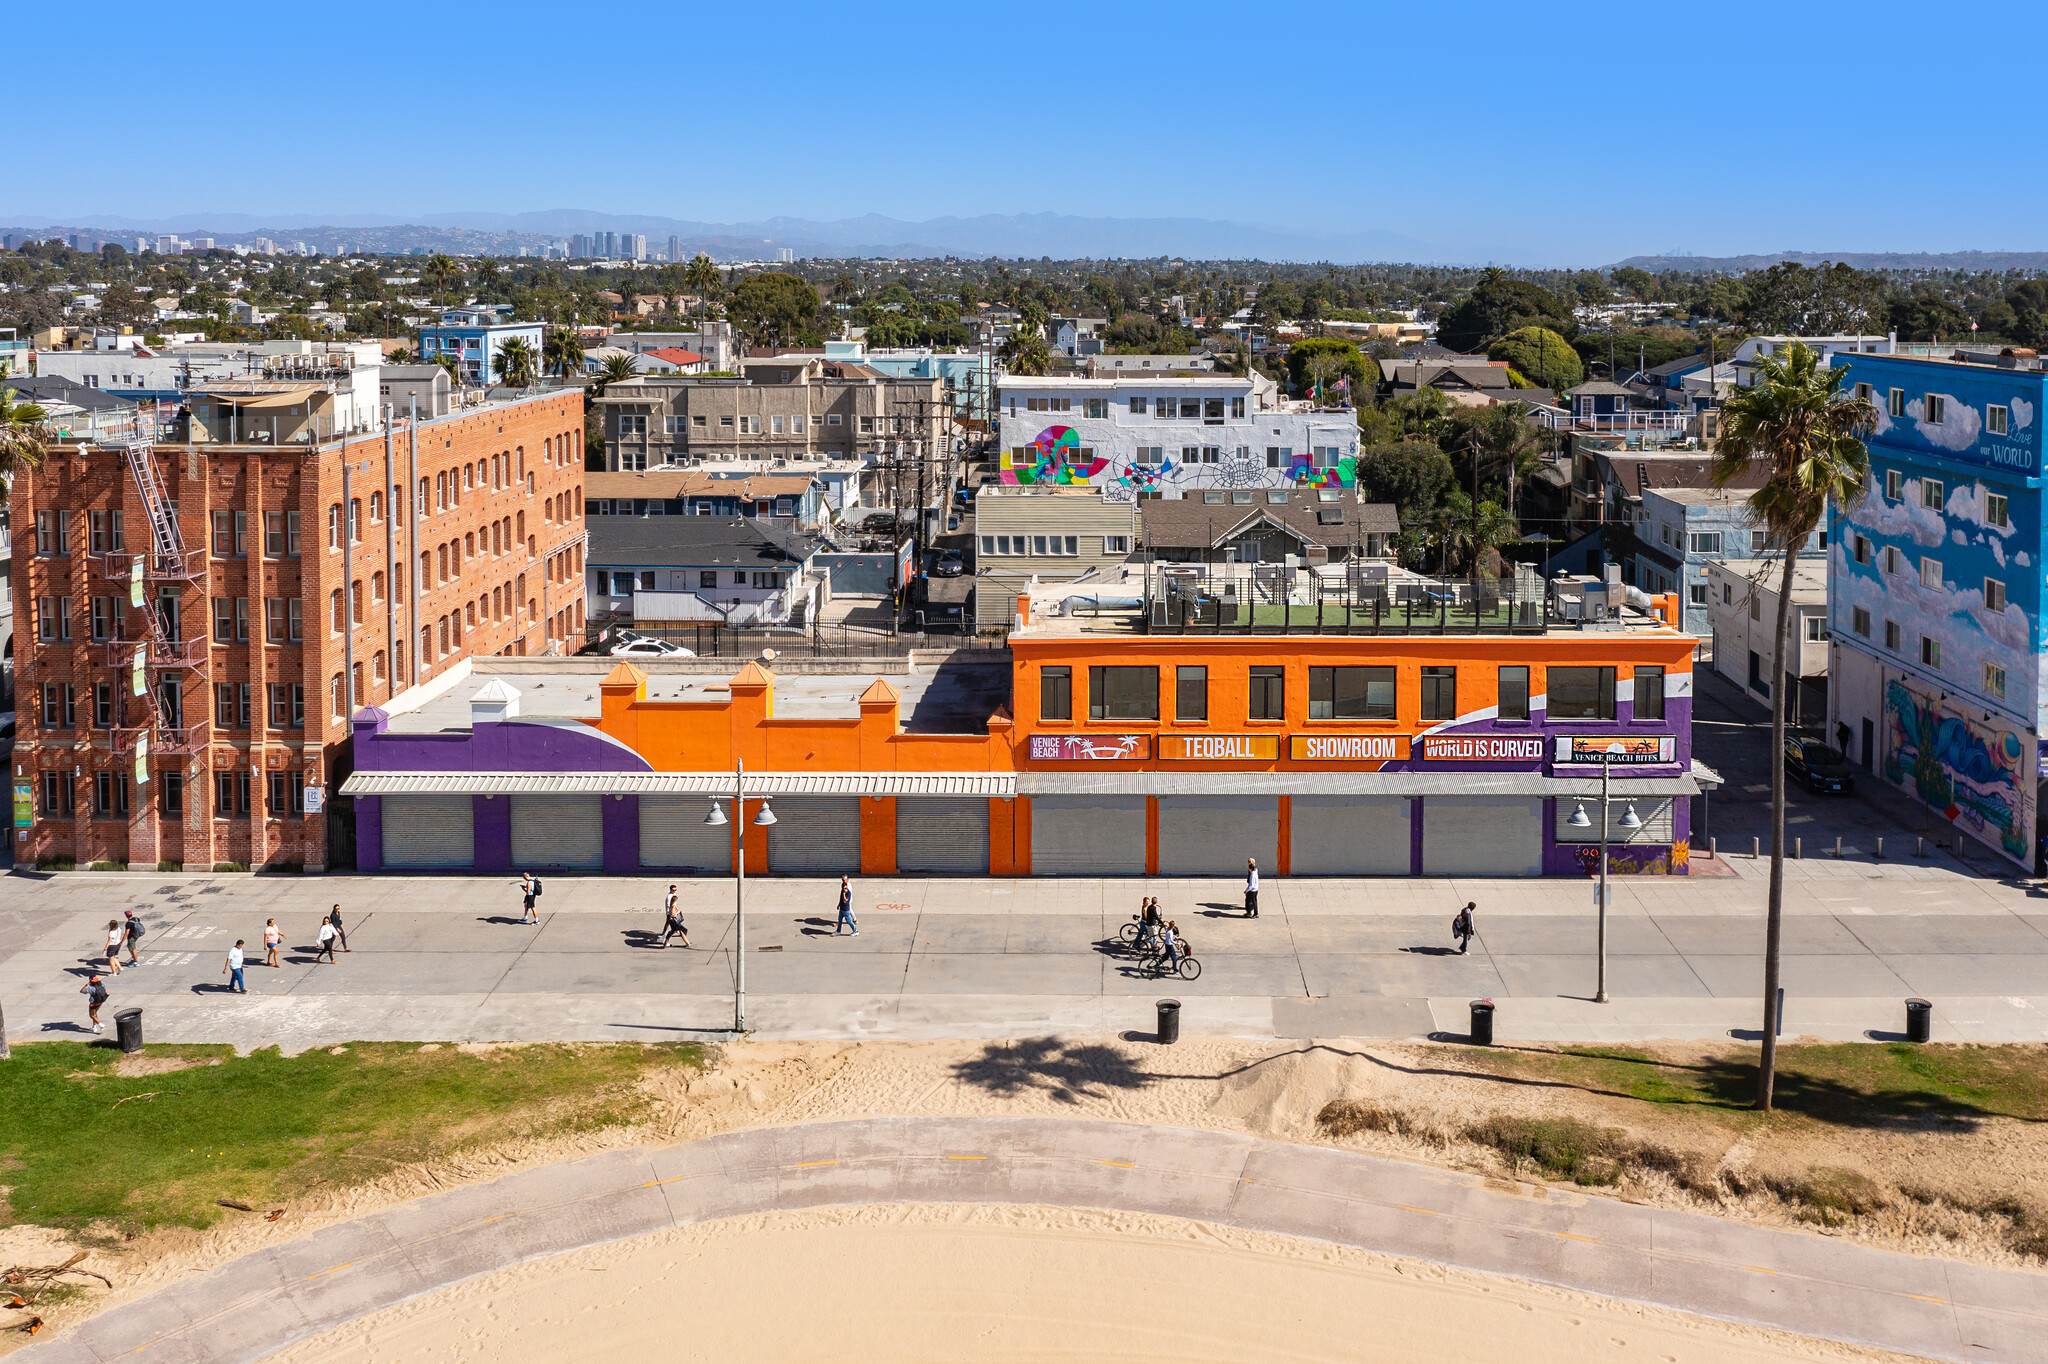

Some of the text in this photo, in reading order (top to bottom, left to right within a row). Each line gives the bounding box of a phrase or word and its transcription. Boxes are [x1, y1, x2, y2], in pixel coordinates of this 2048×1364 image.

[2007, 423, 2032, 445] Love
[1992, 444, 2032, 468] WORLD
[1032, 737, 1060, 748] VENICE
[1183, 737, 1255, 759] TEQBALL
[1306, 738, 1396, 758] SHOWROOM
[1426, 740, 1473, 757] WORLD
[1490, 740, 1543, 758] CURVED
[1032, 747, 1058, 758] BEACH
[1575, 754, 1658, 762] VENICE BEACH BITES
